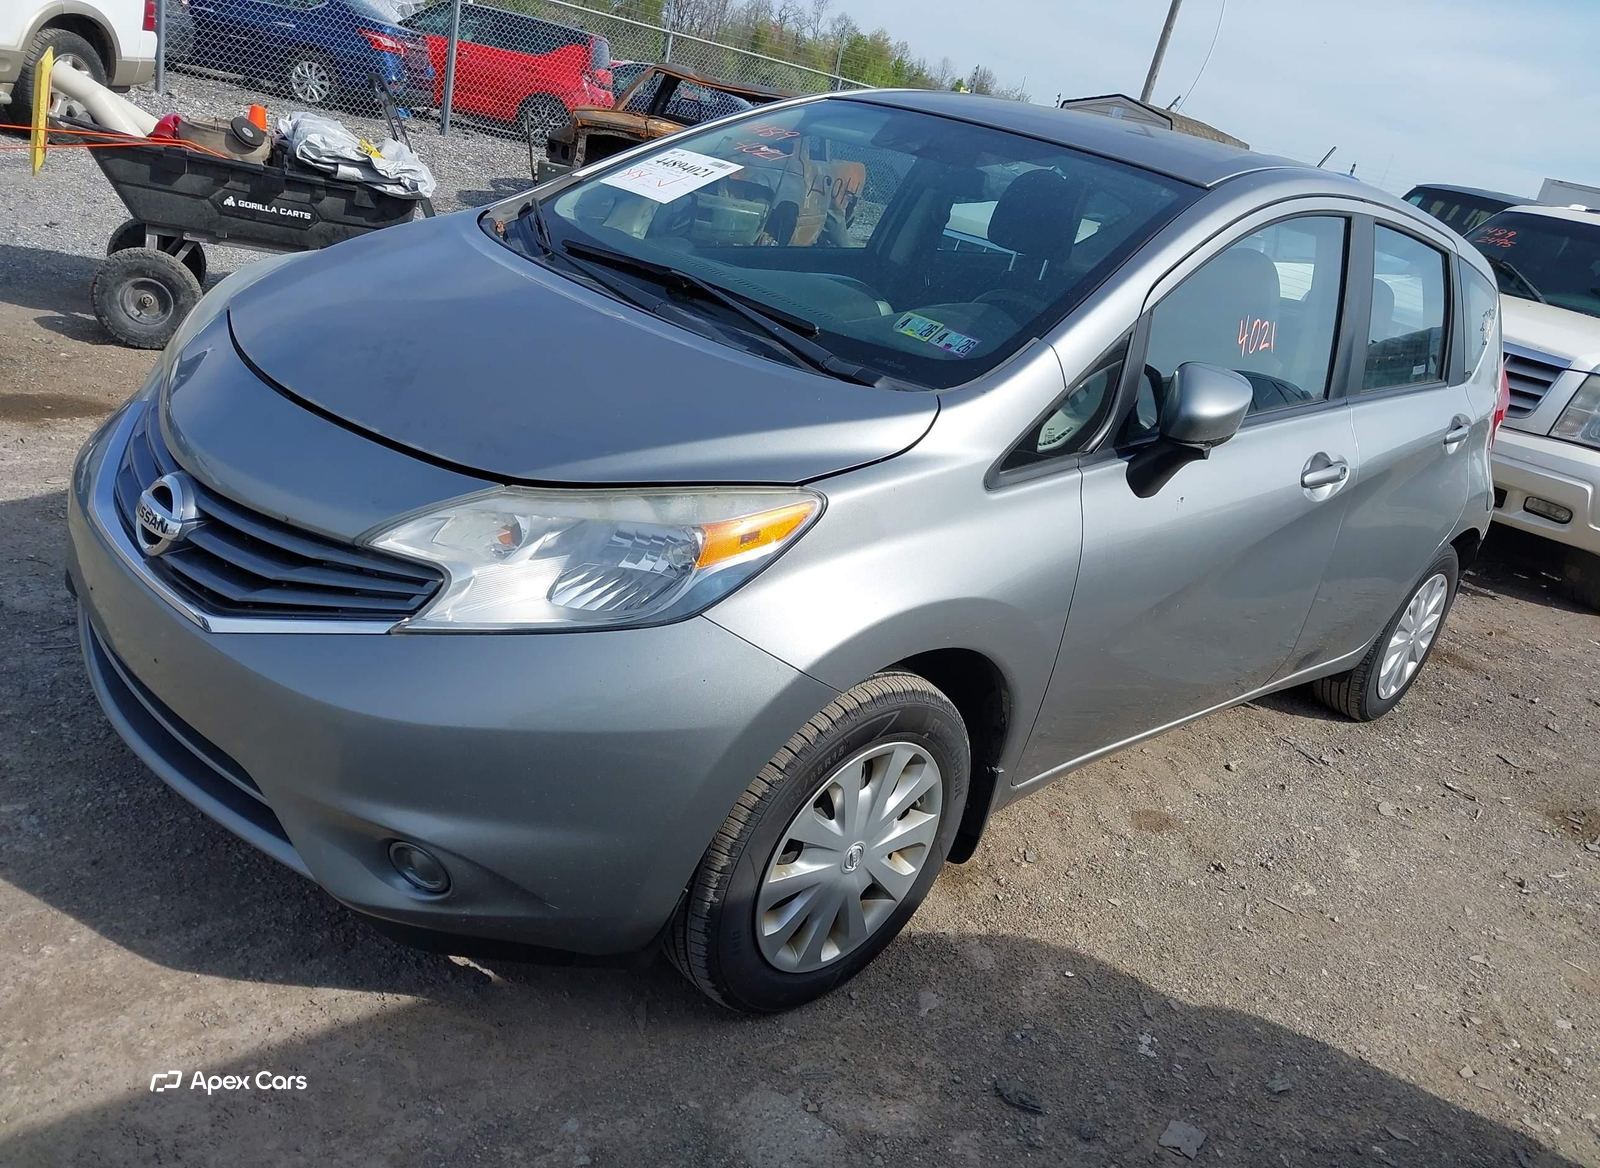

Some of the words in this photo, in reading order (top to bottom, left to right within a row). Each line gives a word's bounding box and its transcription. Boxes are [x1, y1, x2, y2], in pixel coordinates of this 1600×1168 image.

[655, 156, 715, 178] 44894021
[238, 200, 277, 213] GORILLA
[279, 208, 311, 220] CARTS
[898, 318, 912, 329] 4
[919, 323, 939, 337] 26
[1238, 314, 1276, 358] 4021
[936, 332, 950, 344] 4
[956, 339, 977, 354] 26
